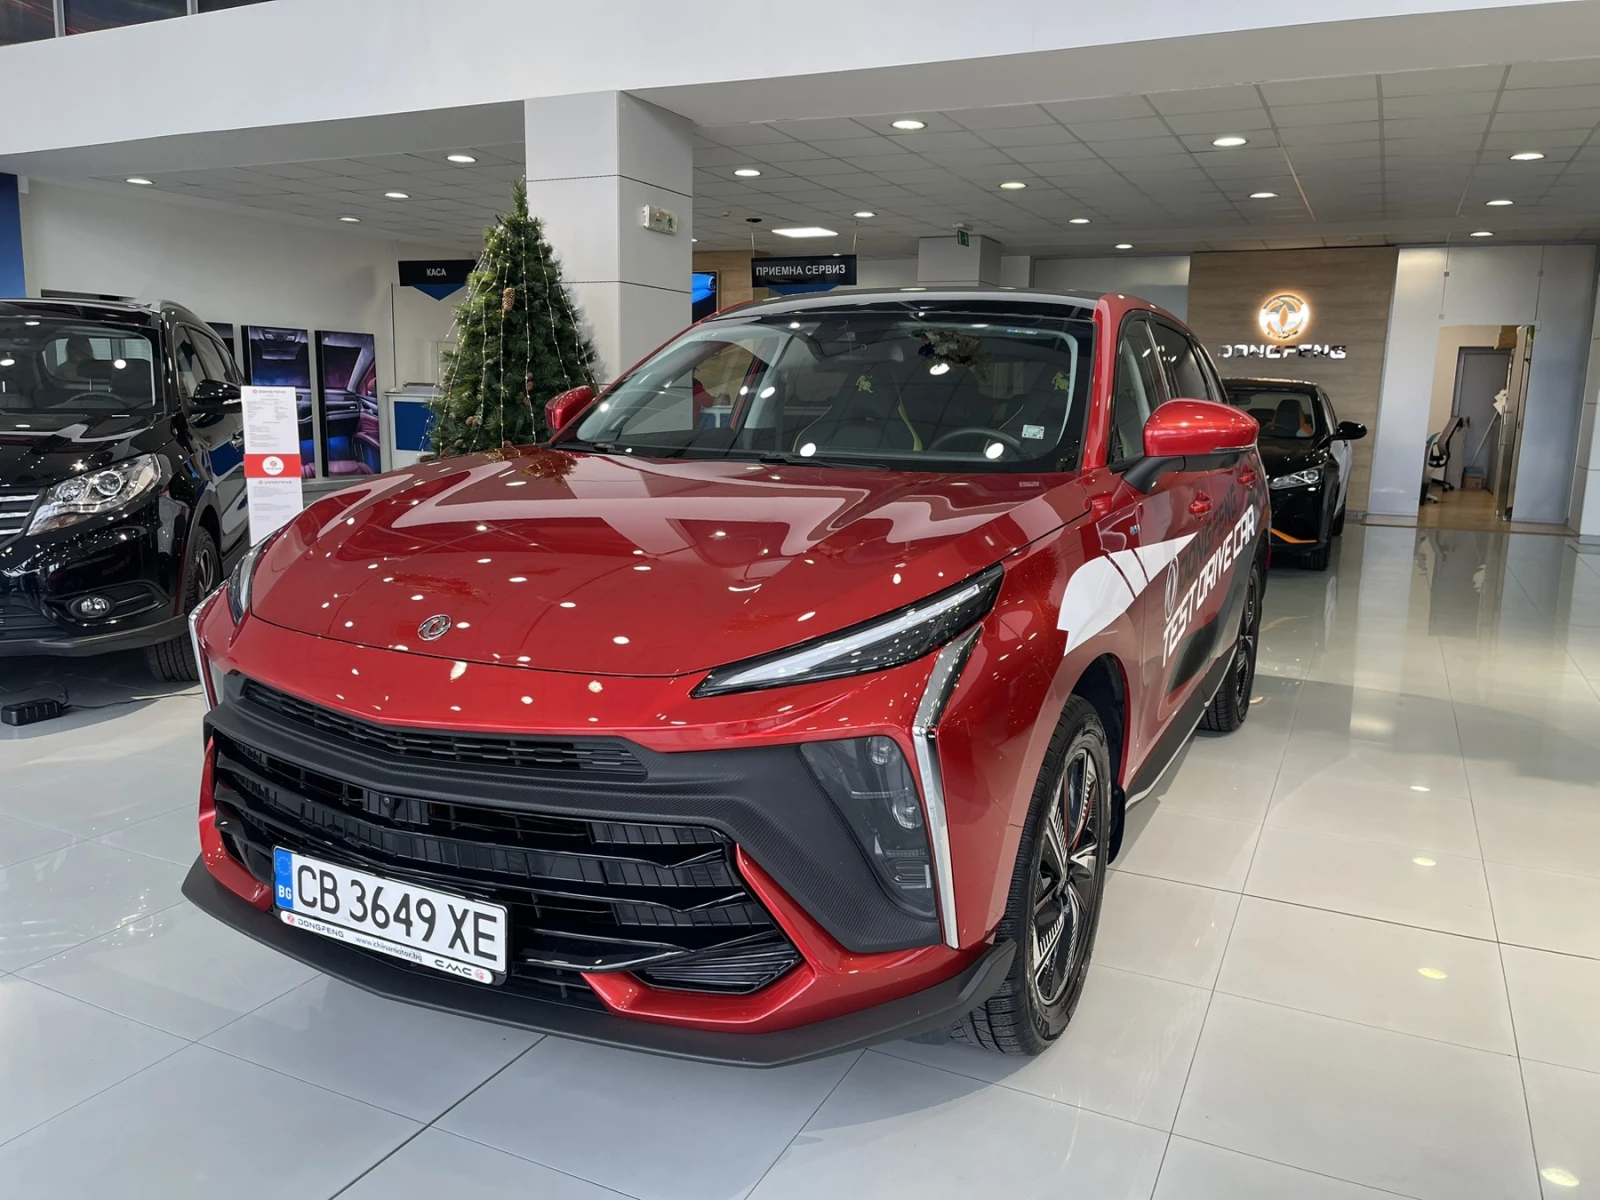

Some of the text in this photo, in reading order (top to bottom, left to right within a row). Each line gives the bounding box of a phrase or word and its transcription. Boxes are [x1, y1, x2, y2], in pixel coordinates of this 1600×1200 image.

[426, 268, 447, 277] КАСА
[756, 264, 846, 276] ПРИЕМНА СЕРВИЗ
[1218, 344, 1347, 359] DONGFENG
[1162, 504, 1255, 667] TEST DRIVE CAR
[278, 885, 292, 900] BG
[349, 880, 436, 942] 3649
[297, 918, 344, 938] DONGFENG
[355, 936, 422, 962] www.chinamotor.bg
[434, 959, 472, 976] CMC
